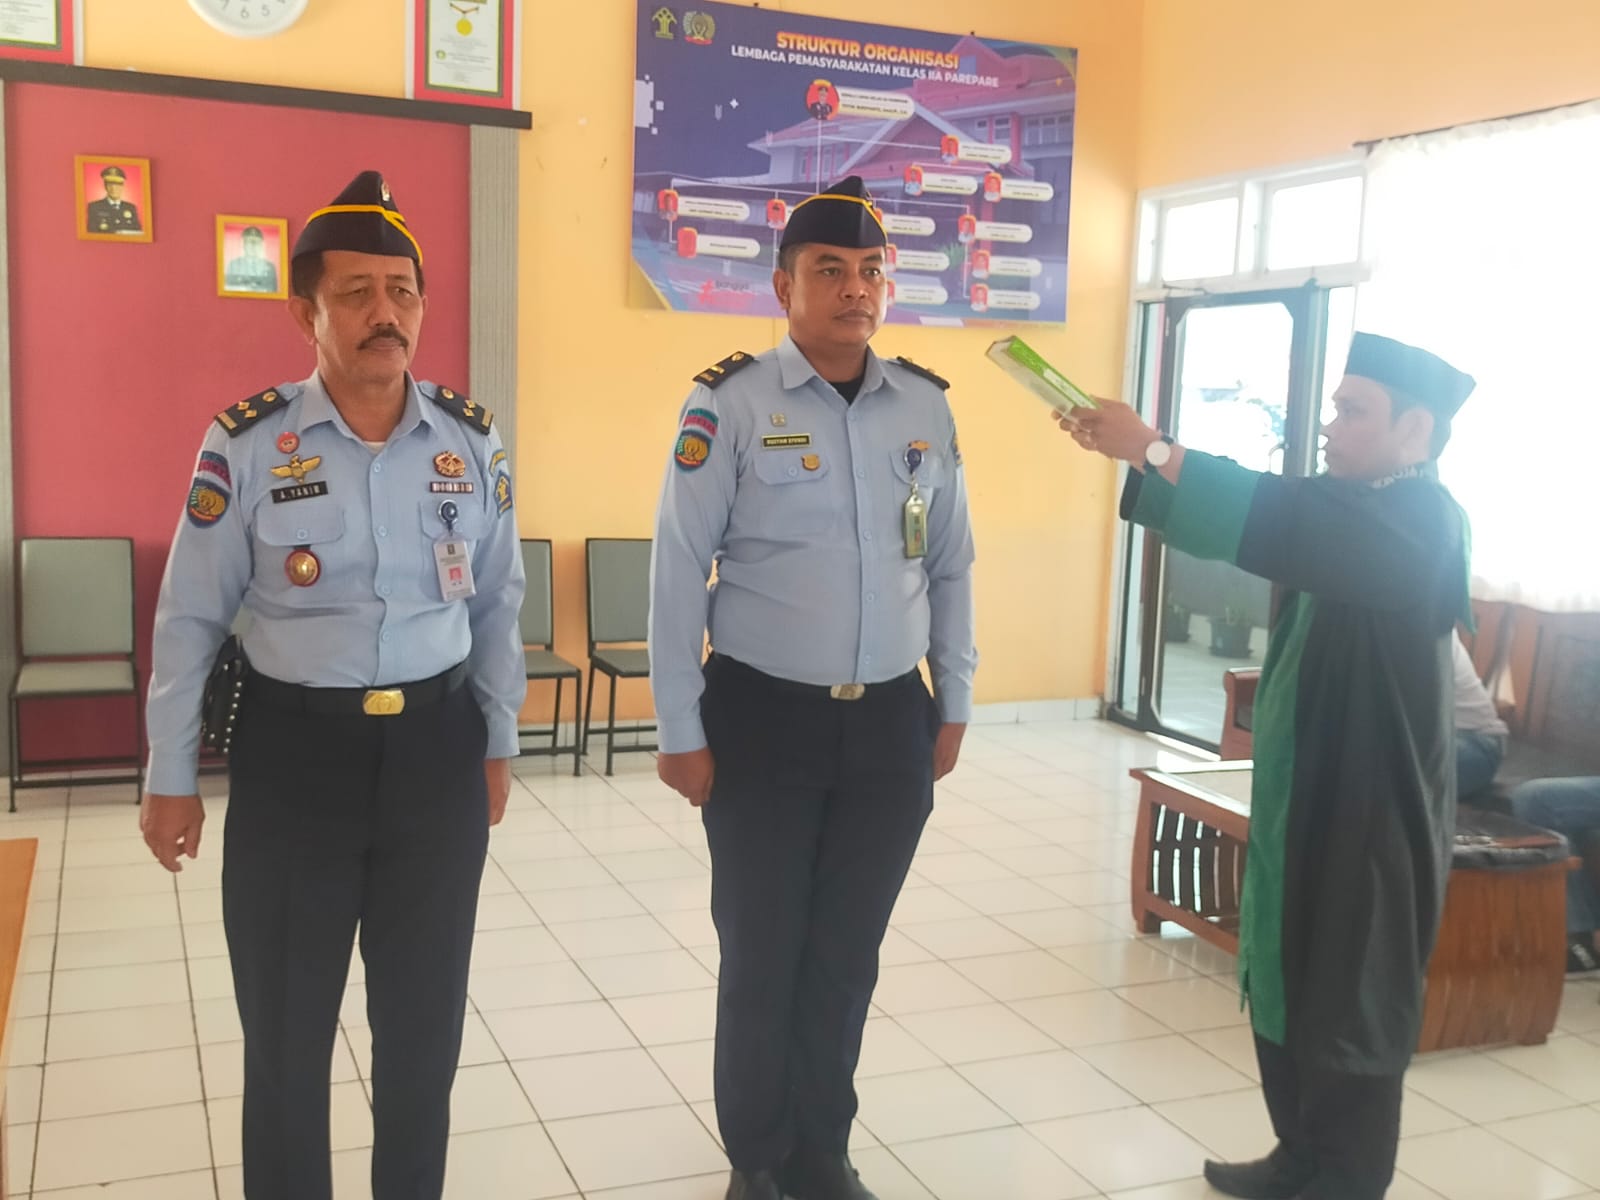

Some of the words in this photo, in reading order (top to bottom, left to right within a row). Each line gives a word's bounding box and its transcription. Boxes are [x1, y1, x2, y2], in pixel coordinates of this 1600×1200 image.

[240, 6, 250, 19] 6
[261, 4, 271, 17] 5
[776, 31, 861, 58] STRUKTUR
[863, 43, 960, 70] ORGANISASI
[731, 45, 786, 63] LEMBAGA
[788, 53, 891, 75] PEMASYARAKATAN
[892, 65, 927, 80] KELAS
[928, 70, 945, 82] IIA
[945, 72, 999, 88] PAREPARE
